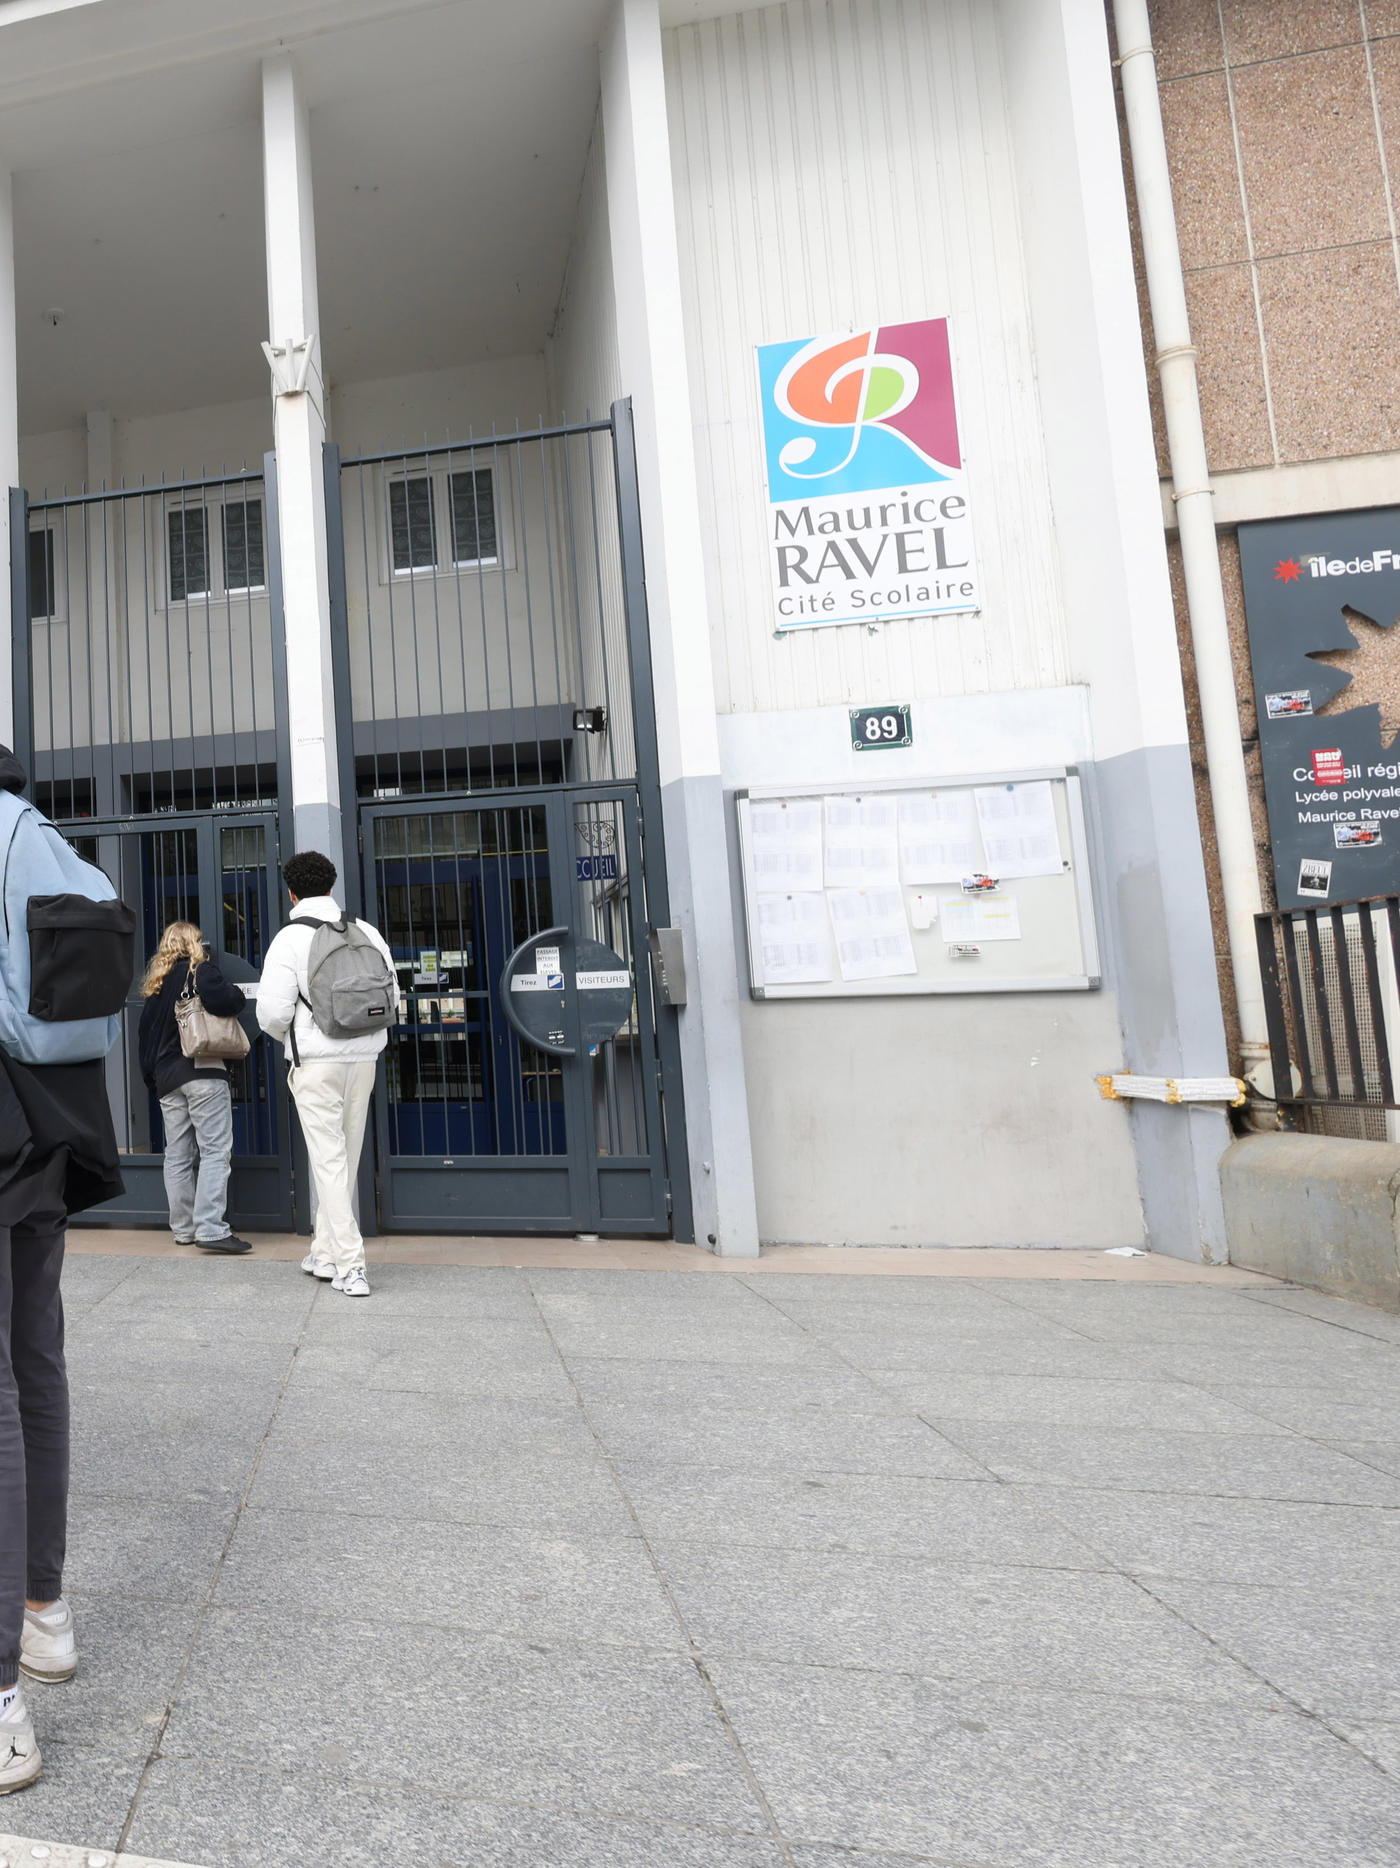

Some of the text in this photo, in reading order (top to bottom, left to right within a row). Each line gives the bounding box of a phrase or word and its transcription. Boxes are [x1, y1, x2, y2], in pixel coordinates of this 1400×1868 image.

[774, 491, 966, 541] Maurice
[776, 526, 969, 588] RAVEL
[778, 580, 974, 616] Cité Scolaire
[865, 715, 898, 740] 89
[1292, 764, 1361, 782] Coeil
[1295, 789, 1338, 805] Lycée
[1298, 805, 1400, 823] Maurice Rave
[578, 976, 625, 985] VISITEURS
